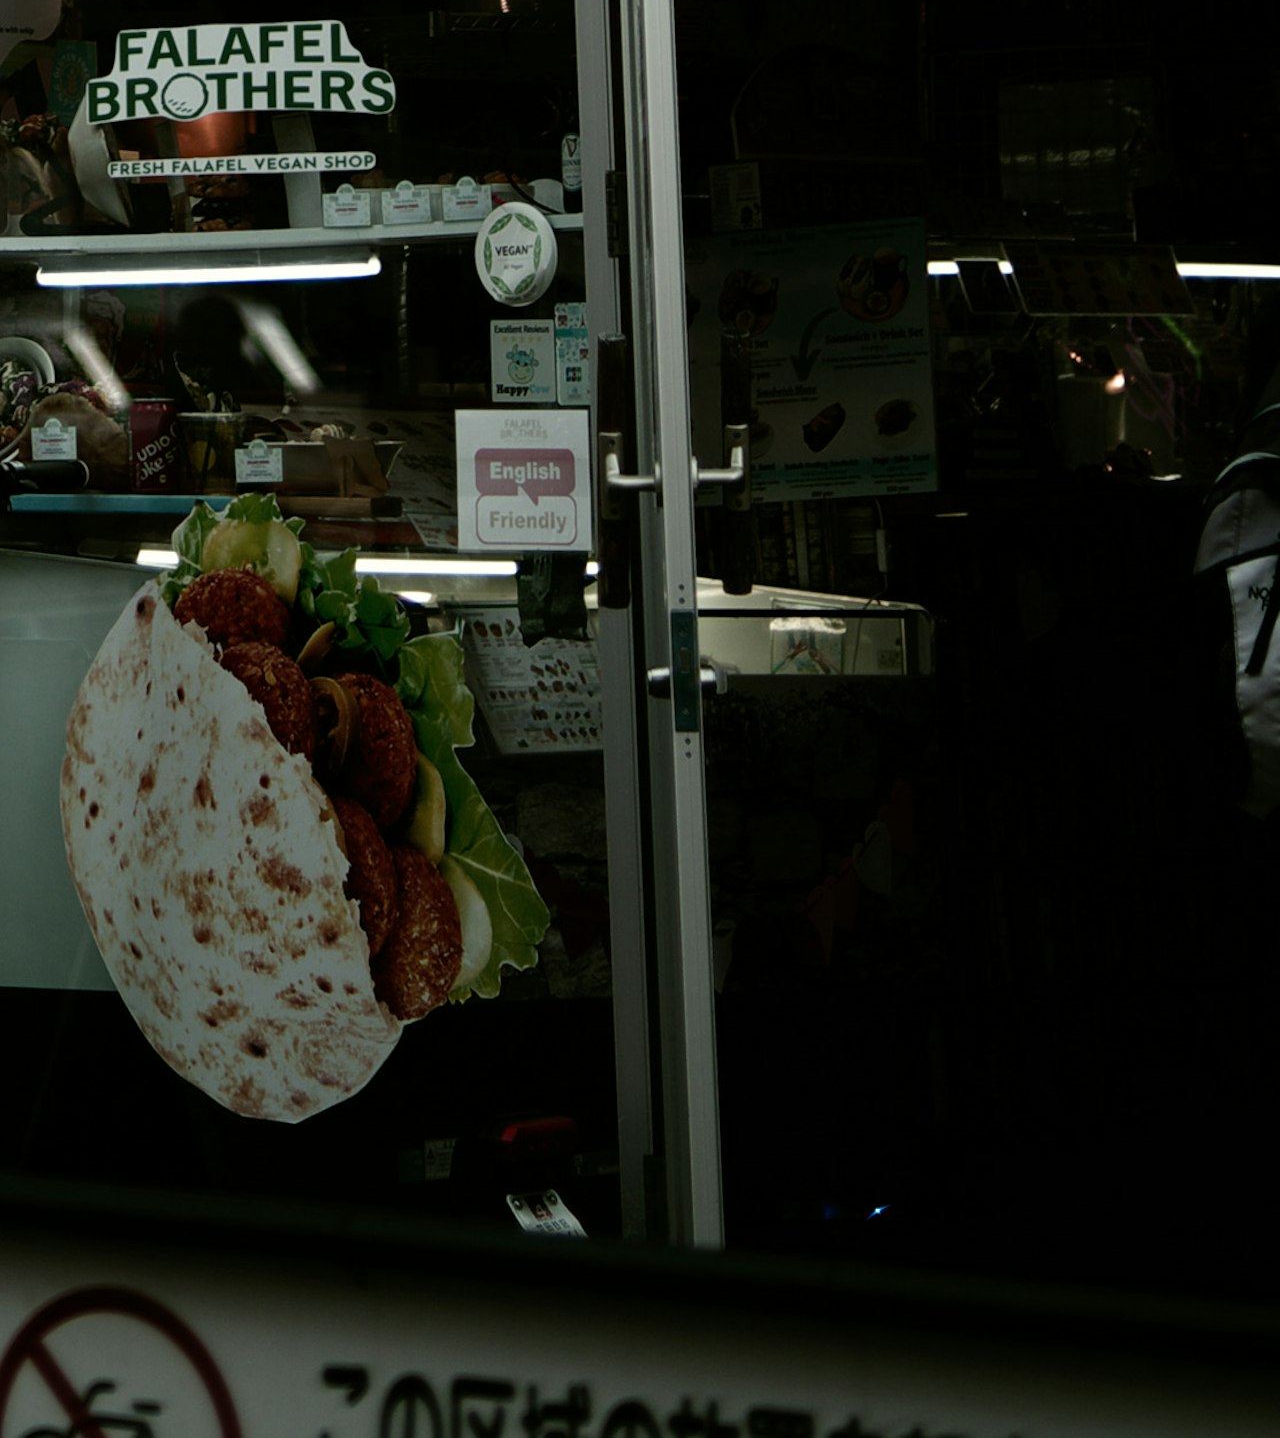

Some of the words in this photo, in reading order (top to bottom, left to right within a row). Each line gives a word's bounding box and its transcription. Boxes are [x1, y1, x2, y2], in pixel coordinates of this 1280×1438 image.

[118, 23, 362, 72] FALAFEL
[87, 69, 396, 124] BROTHERS
[109, 160, 166, 177] FRESH
[170, 157, 248, 175] FALAFEL
[253, 154, 319, 172] VEGAN
[323, 153, 376, 170] SHOP
[489, 461, 561, 484] English
[489, 510, 568, 535] Friendly
